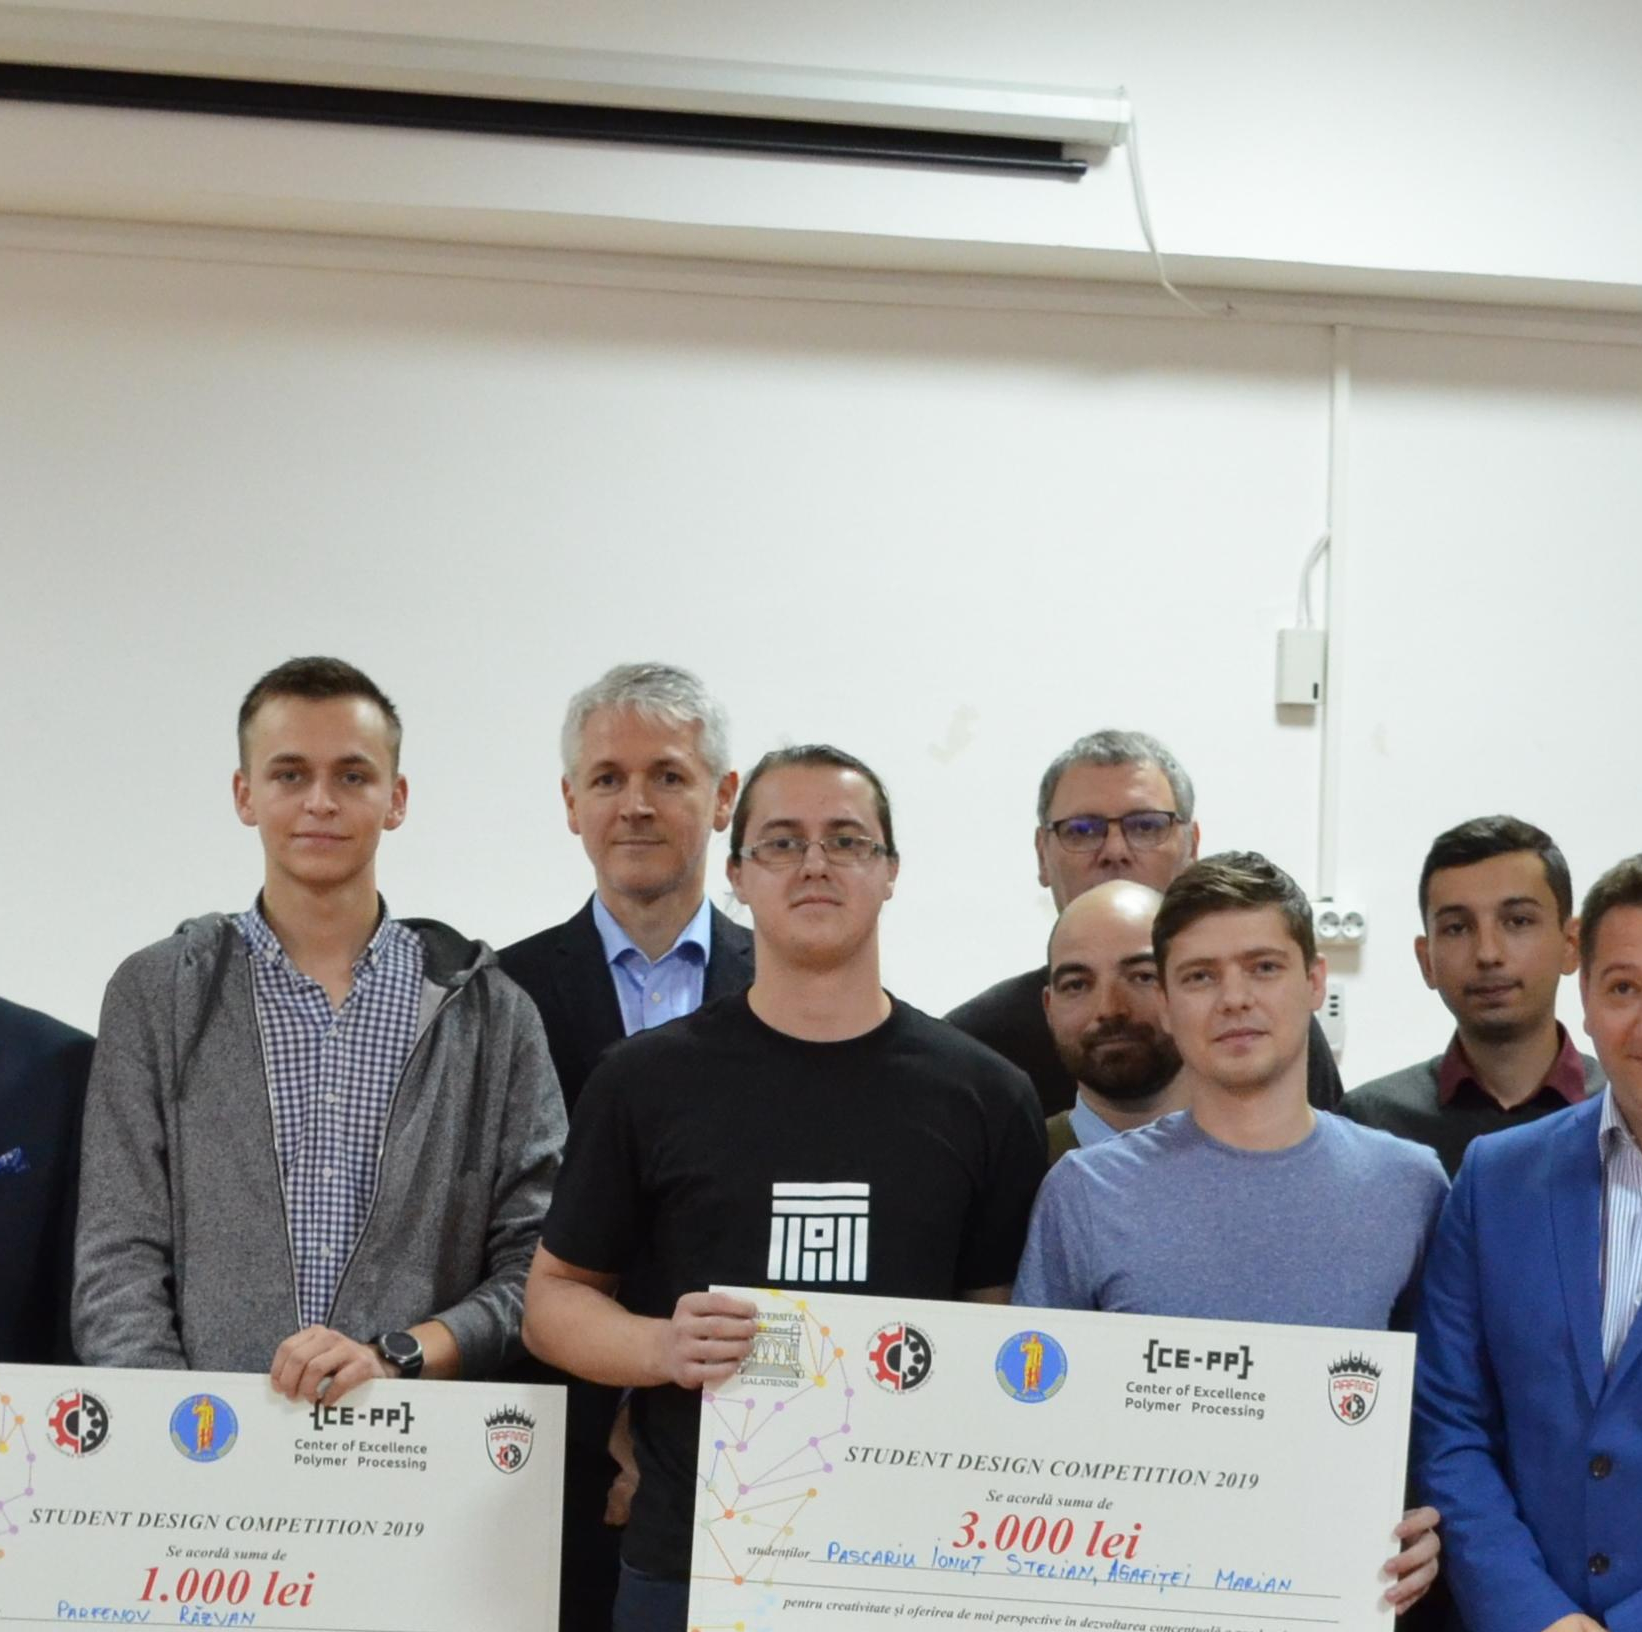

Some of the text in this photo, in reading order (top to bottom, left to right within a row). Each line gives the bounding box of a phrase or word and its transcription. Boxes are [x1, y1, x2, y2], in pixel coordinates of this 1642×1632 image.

[1125, 1380, 1266, 1402] Center of Excellence
[1124, 1396, 1265, 1420] Polymer Processing
[293, 1438, 427, 1454] Center of Excellence
[293, 1452, 427, 1472] Polymer Processing
[844, 1446, 1259, 1489] STUDENT DESIGN COMPETITION 2019
[984, 1488, 1113, 1510] Se acordă suma de
[29, 1508, 424, 1537] STUDENT DESIGN COMPETITION 2019
[953, 1511, 1142, 1560] 3.000 lei
[165, 1544, 182, 1557] Se
[233, 1550, 268, 1560] suma
[270, 1548, 287, 1561] de
[140, 1566, 316, 1608] 1.000 lei
[781, 1598, 823, 1609] pentru
[825, 1601, 891, 1614] creativitate
[906, 1605, 954, 1618] oferirea
[956, 1607, 972, 1620] de
[973, 1610, 994, 1621] noi
[994, 1613, 1062, 1626] perspective
[1079, 1616, 1146, 1632] dezvoltarea
